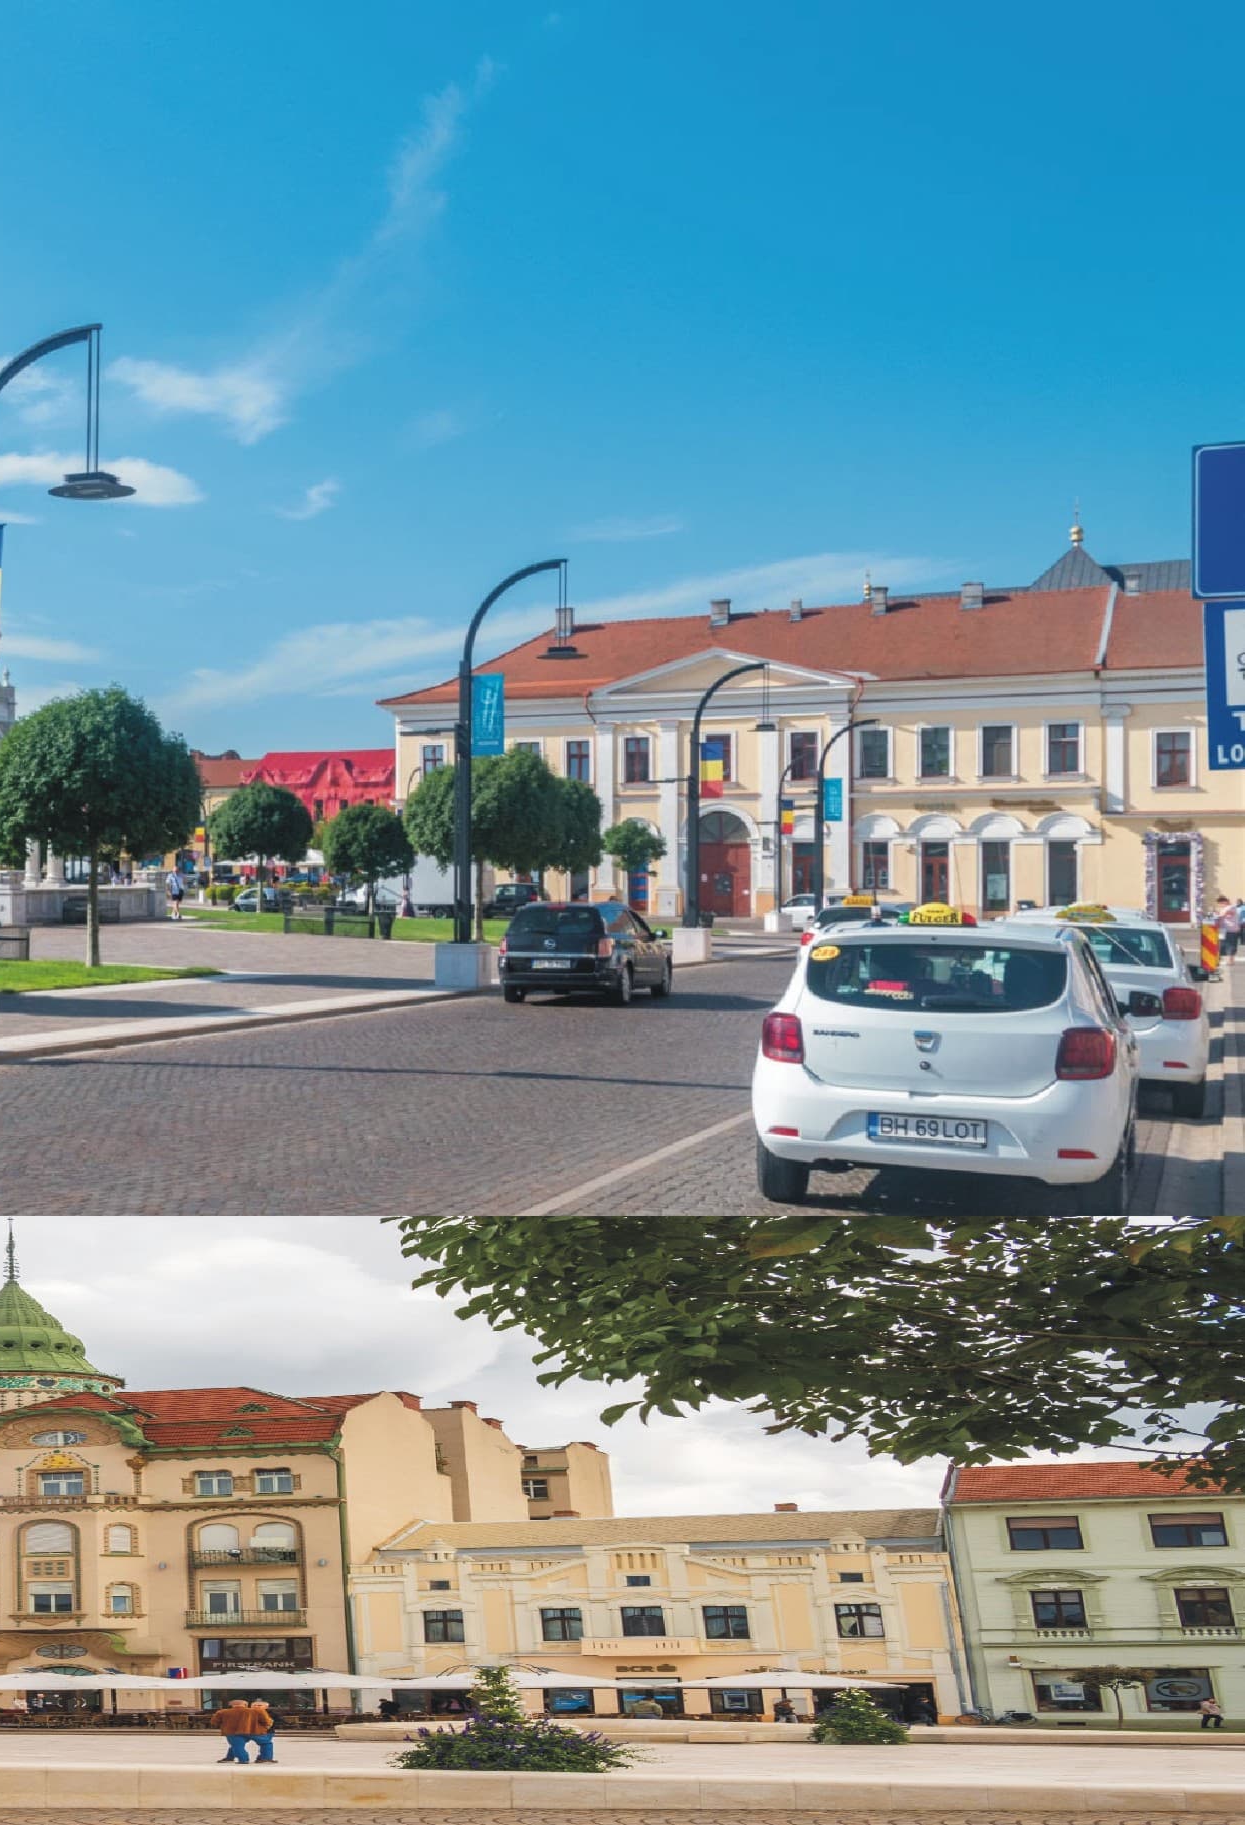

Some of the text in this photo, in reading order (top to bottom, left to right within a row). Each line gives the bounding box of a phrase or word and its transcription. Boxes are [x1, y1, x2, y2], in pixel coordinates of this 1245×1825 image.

[1217, 744, 1245, 764] LO
[880, 1117, 980, 1140] BH 69 LOT
[616, 1665, 653, 1673] BCR
